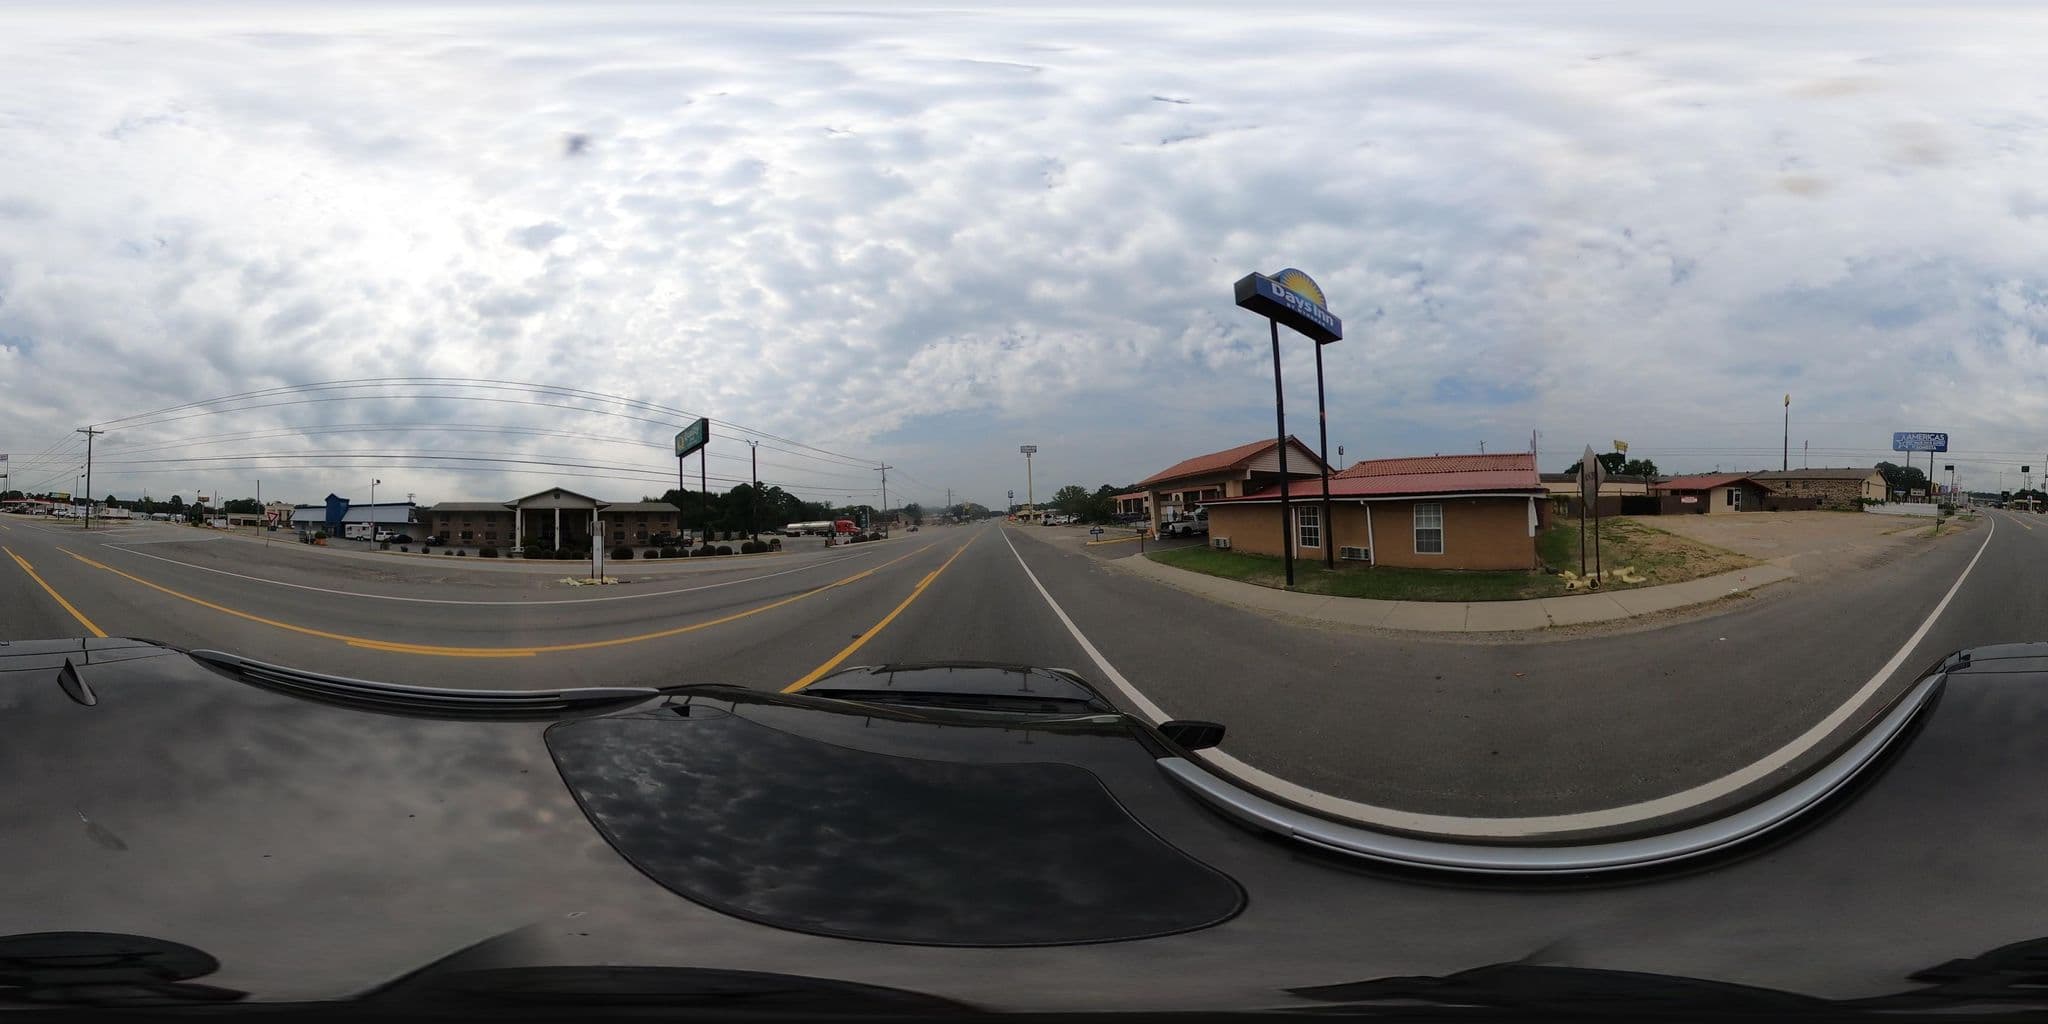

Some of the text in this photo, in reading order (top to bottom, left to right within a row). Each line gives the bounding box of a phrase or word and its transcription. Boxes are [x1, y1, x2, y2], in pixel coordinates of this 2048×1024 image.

[1271, 282, 1312, 312] Days
[1312, 303, 1334, 326] Inn
[1906, 433, 1945, 441] AMERICAS
